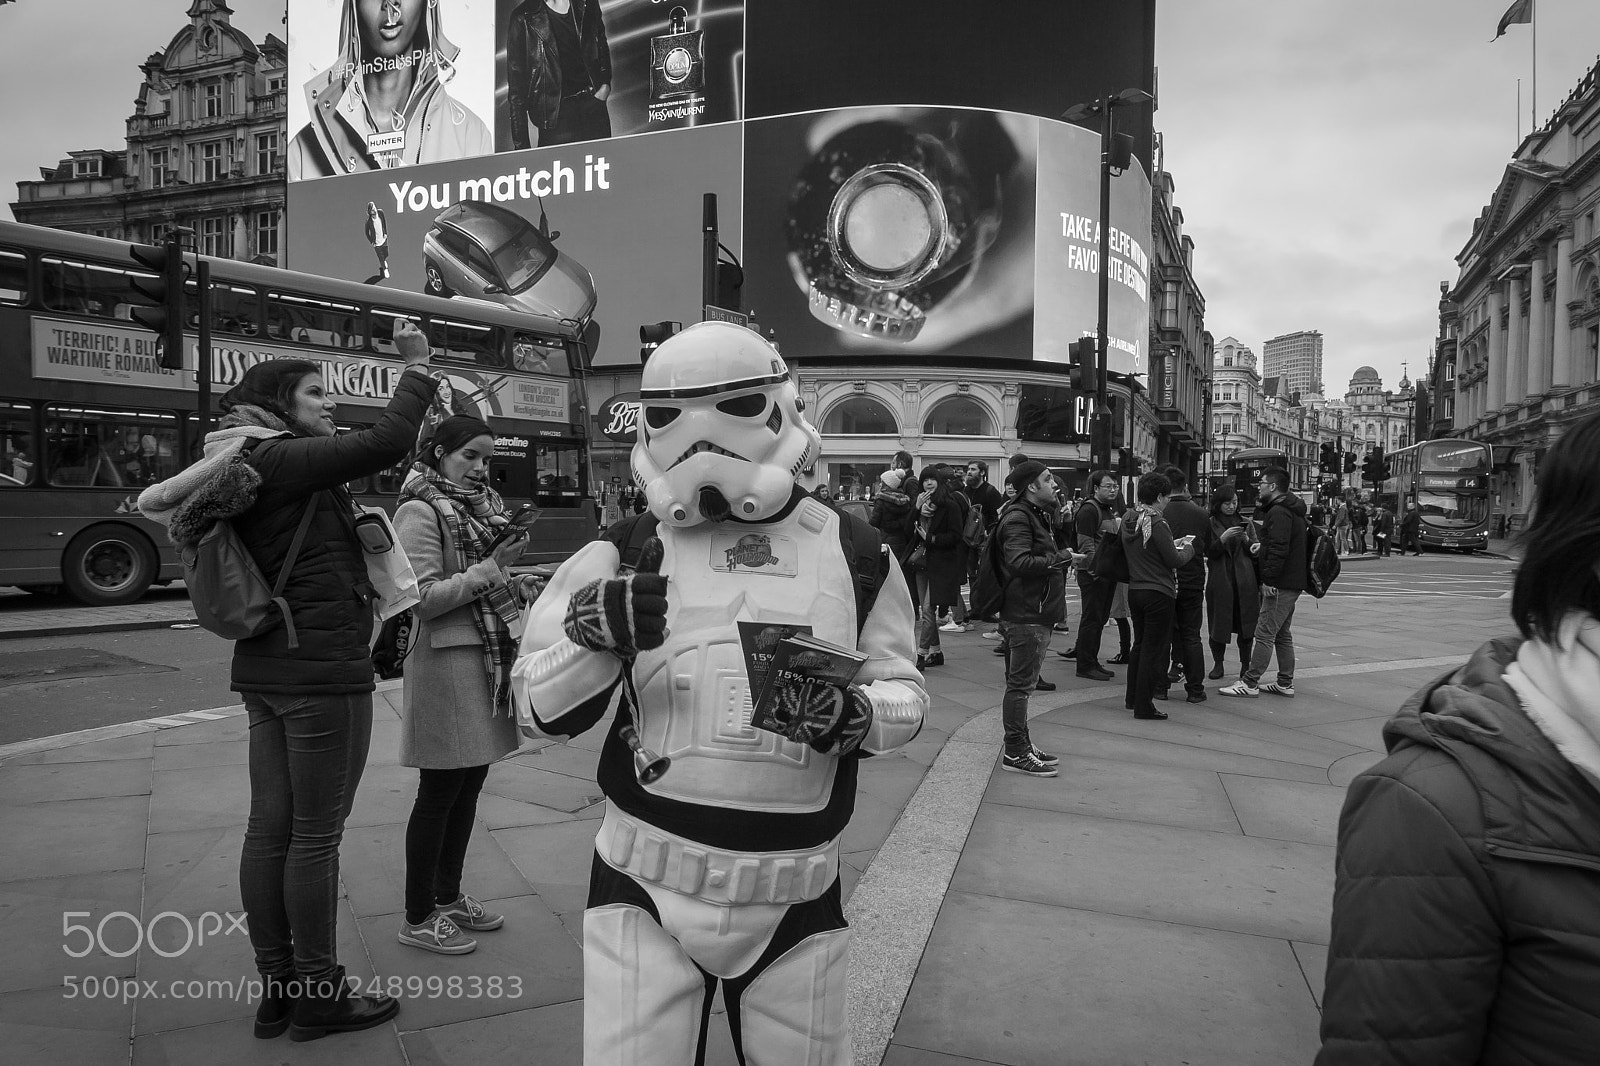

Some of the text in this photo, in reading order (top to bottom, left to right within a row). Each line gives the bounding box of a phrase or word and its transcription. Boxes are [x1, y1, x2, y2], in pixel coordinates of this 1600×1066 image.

[370, 136, 403, 147] HUNTER
[388, 154, 610, 214] You match it
[1060, 212, 1092, 243] TAKE
[711, 310, 726, 322] BUS
[123, 337, 132, 354] A
[47, 346, 111, 370] WARTIME
[1253, 469, 1261, 477] 19
[1465, 479, 1476, 488] 14
[724, 544, 761, 563] PLANET
[726, 552, 780, 572] HOLLYWOOD
[777, 669, 804, 683] 15%
